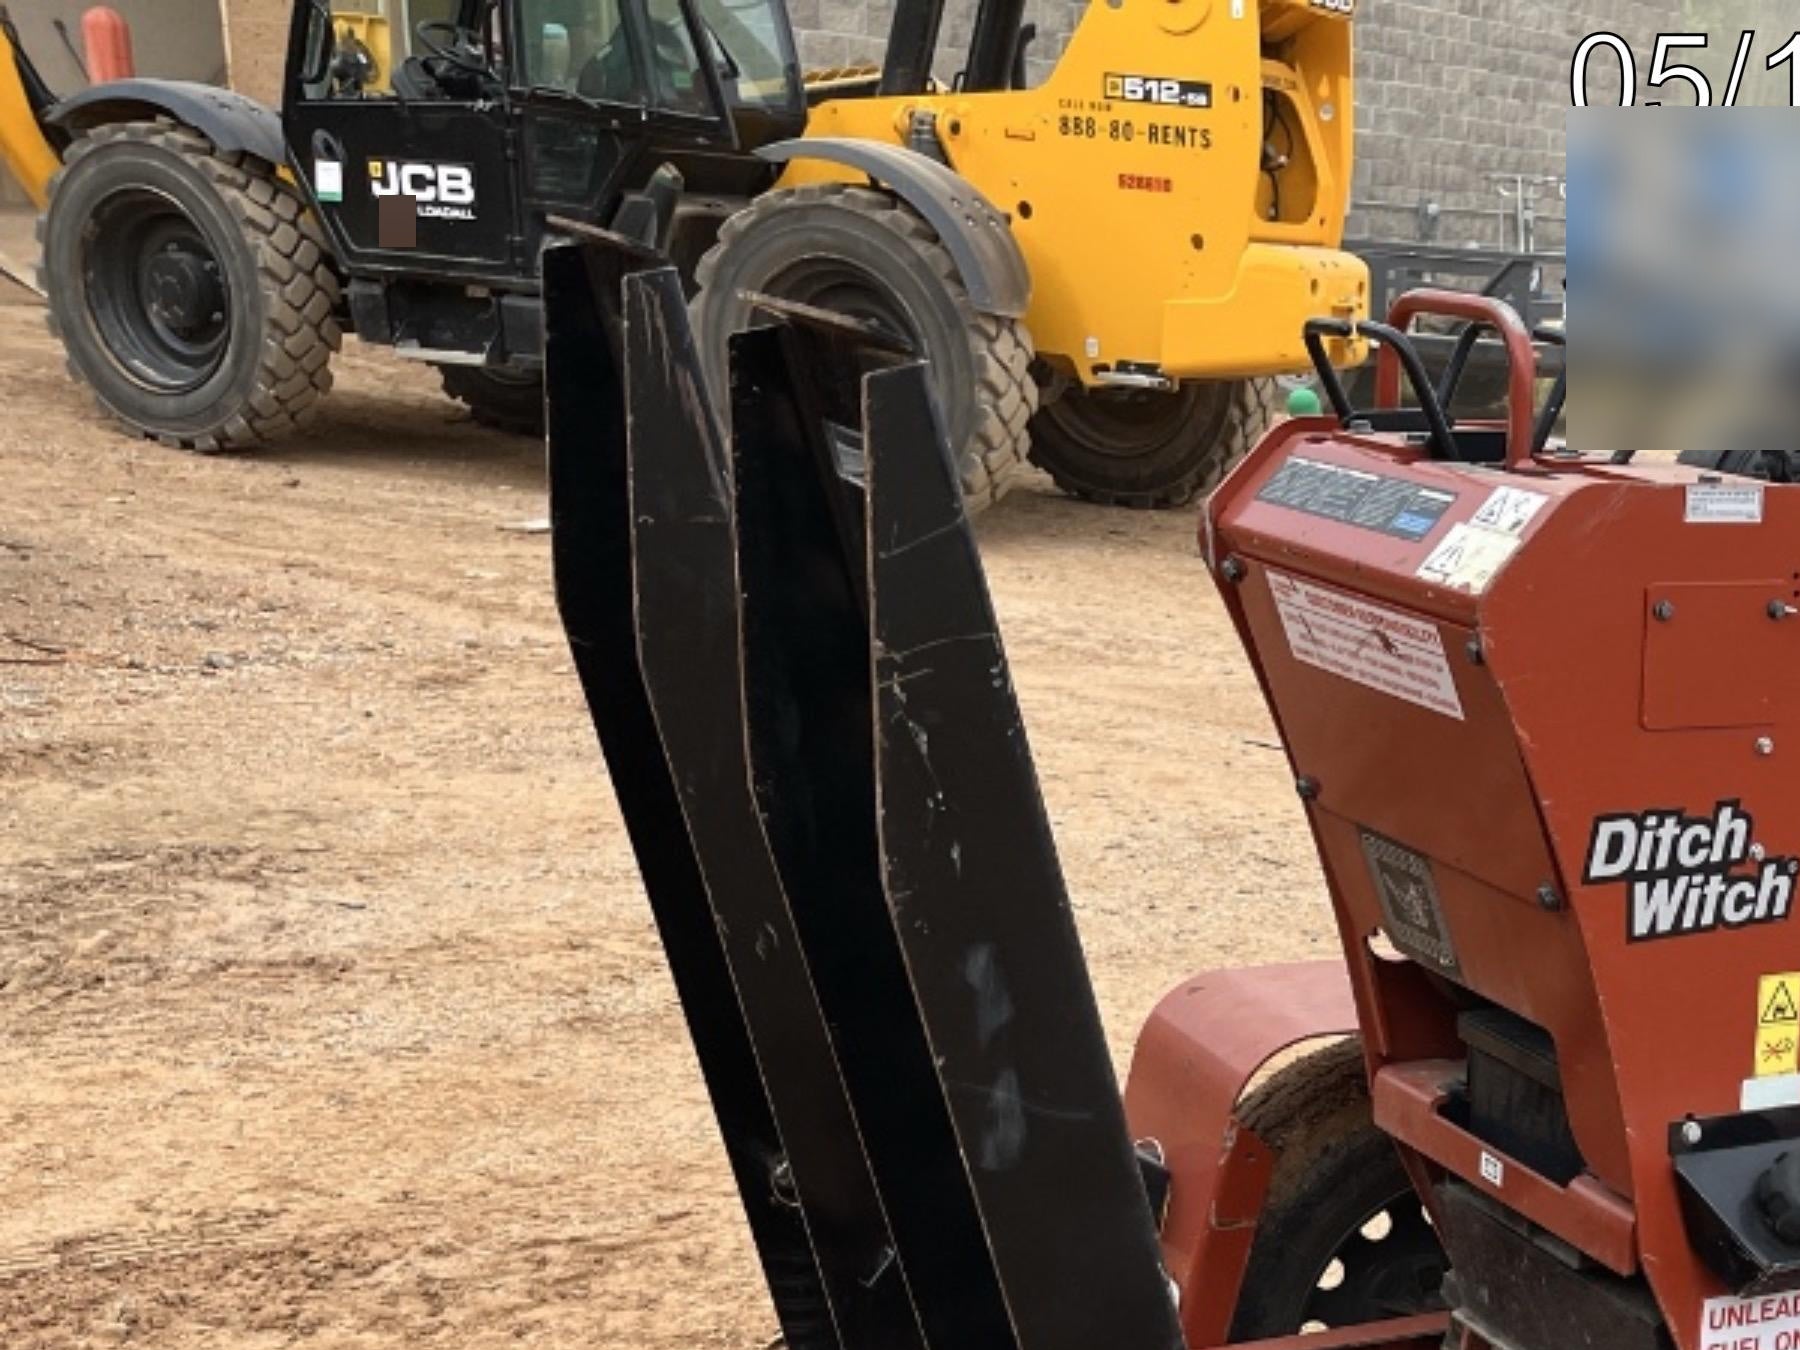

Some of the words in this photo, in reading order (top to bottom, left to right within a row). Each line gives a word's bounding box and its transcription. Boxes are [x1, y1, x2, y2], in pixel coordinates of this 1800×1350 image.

[367, 161, 475, 204] JCB
[1588, 804, 1750, 880] Ditch
[1632, 862, 1794, 938] Witch
